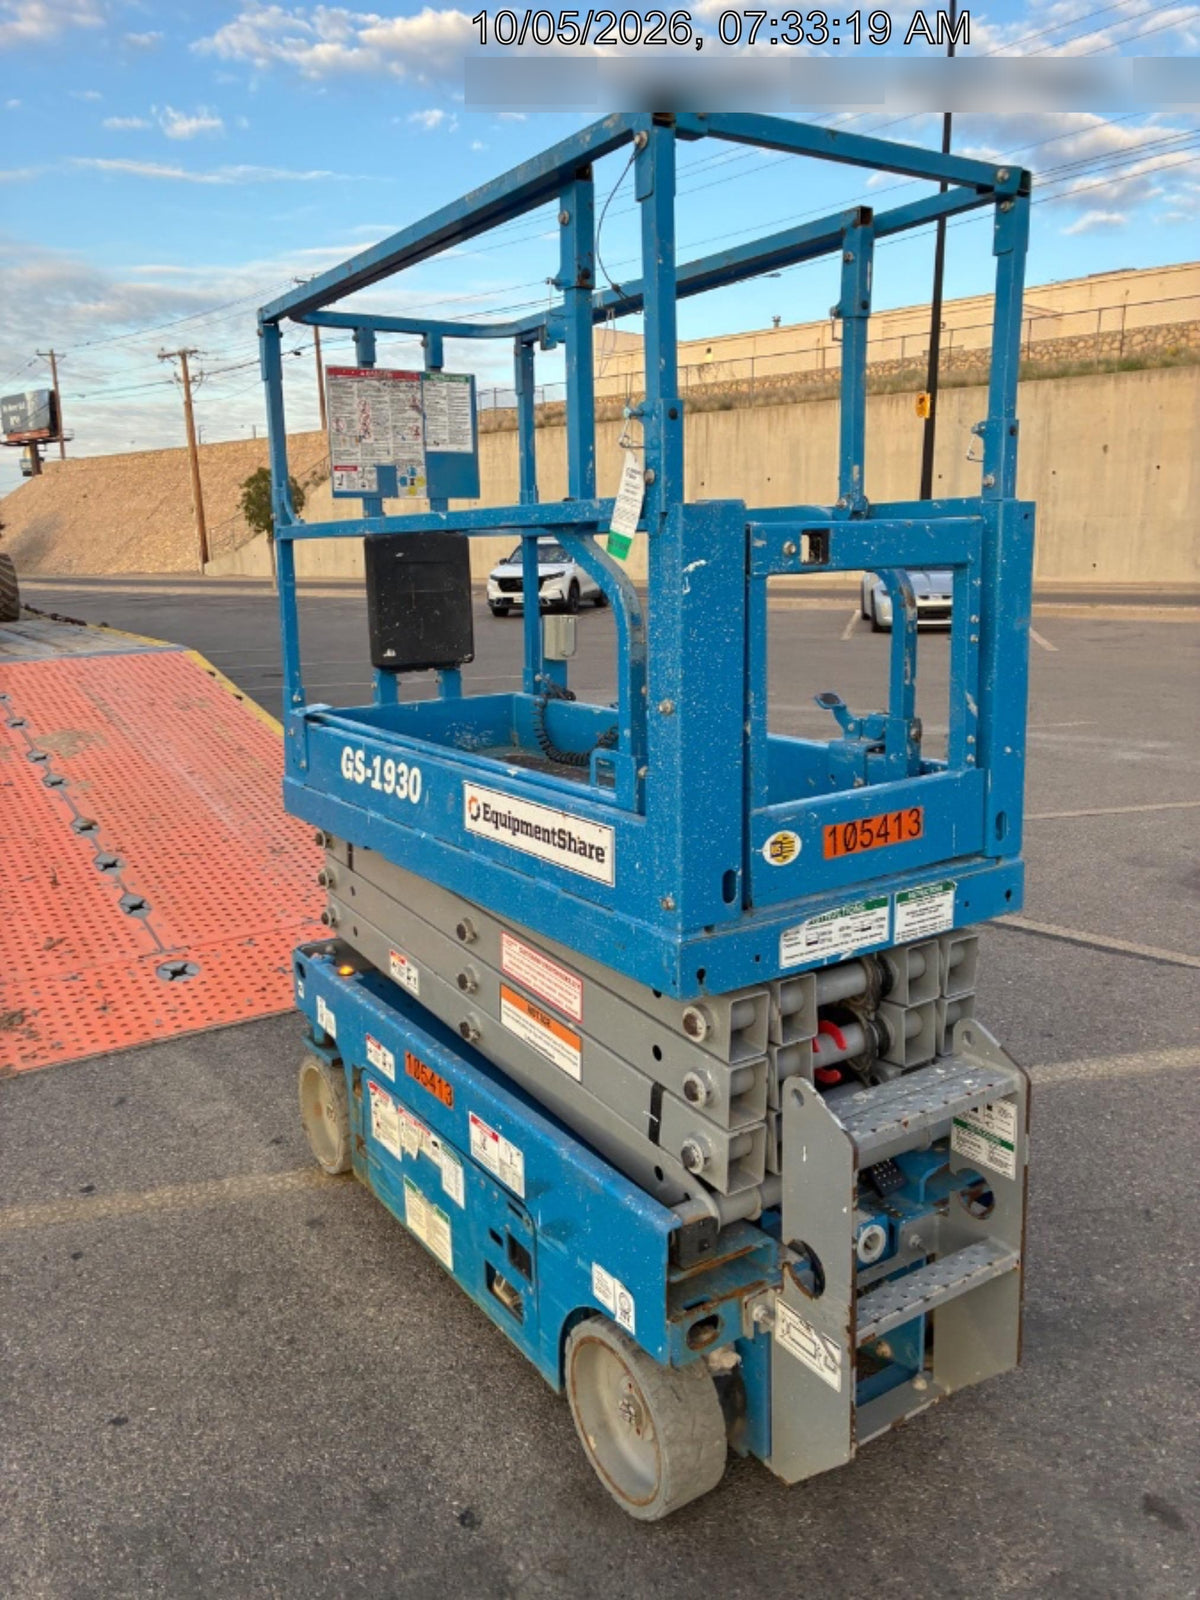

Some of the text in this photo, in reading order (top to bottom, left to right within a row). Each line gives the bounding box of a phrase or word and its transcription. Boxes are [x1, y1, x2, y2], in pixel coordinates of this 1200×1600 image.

[341, 746, 422, 804] GS-1930
[482, 802, 606, 863] EquipmentShare
[828, 807, 922, 855] 105413
[406, 1054, 453, 1106] 105413
